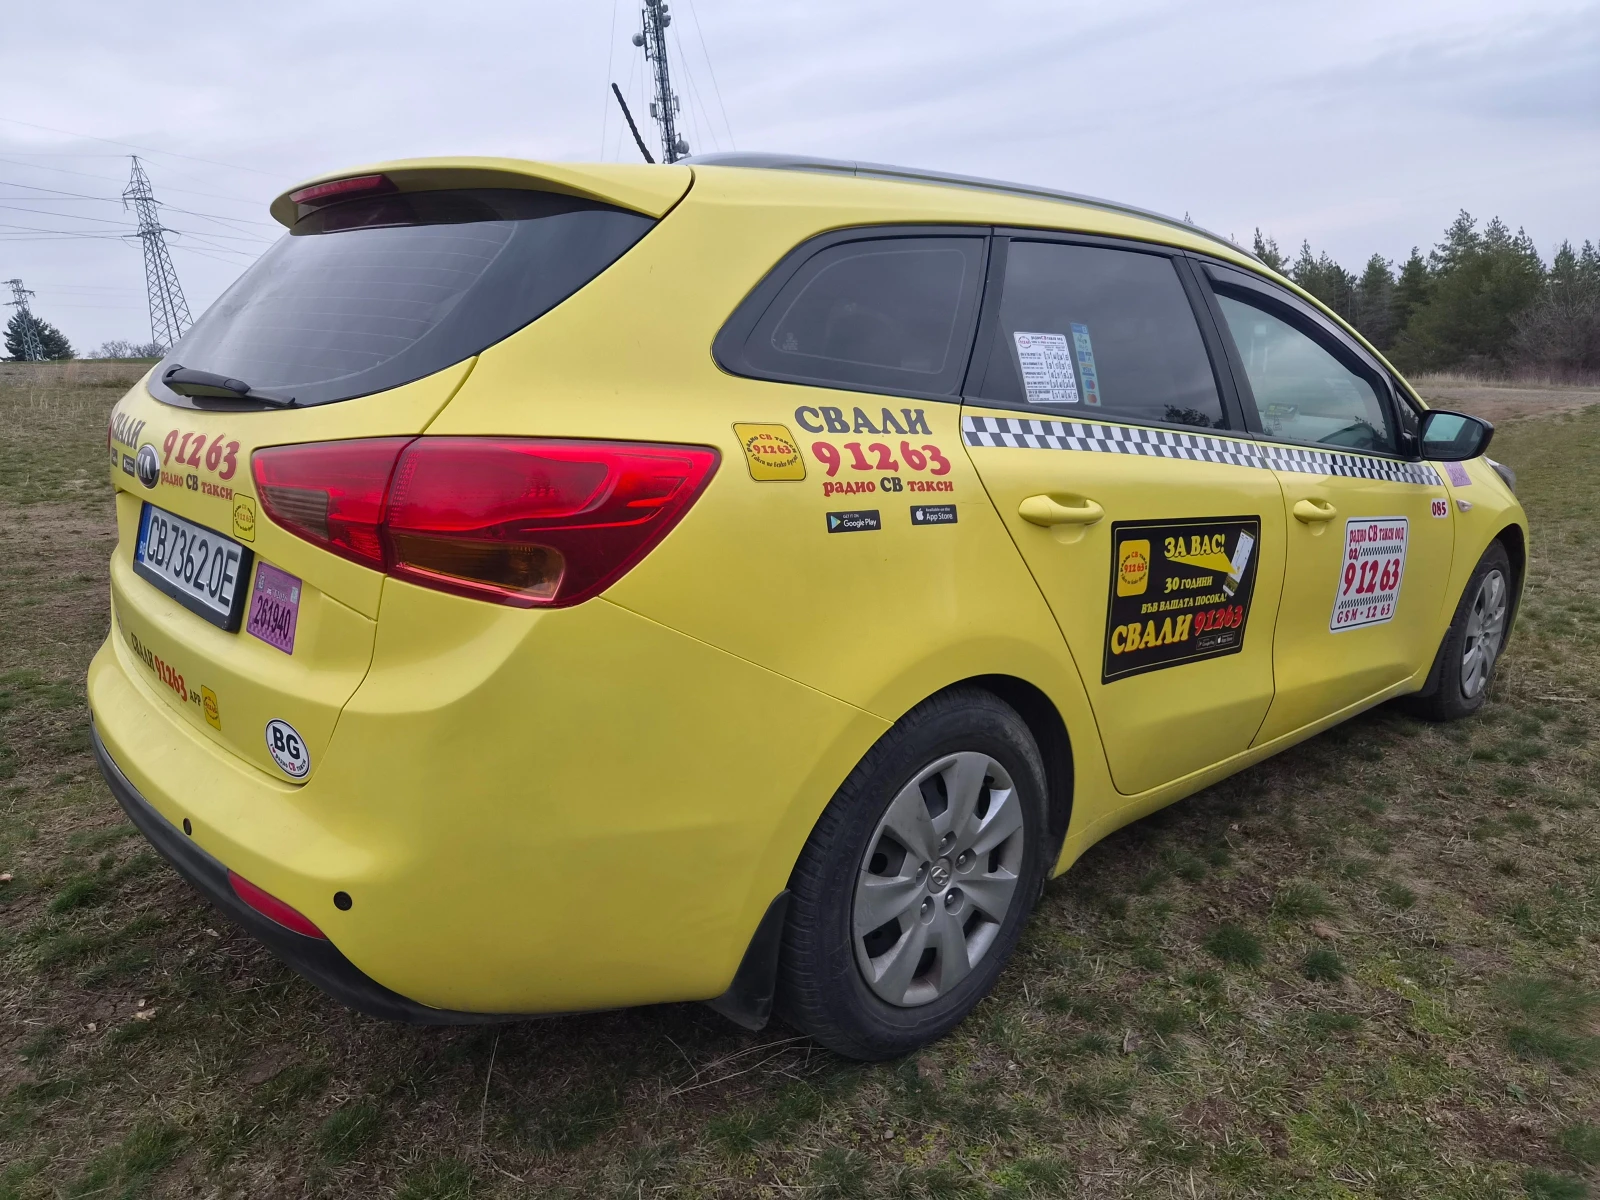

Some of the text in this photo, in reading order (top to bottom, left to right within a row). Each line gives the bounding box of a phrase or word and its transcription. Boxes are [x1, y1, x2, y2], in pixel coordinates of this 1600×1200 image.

[794, 406, 932, 435] СВАЛИ
[163, 429, 240, 480] 91263
[812, 440, 952, 478] 91263
[160, 471, 233, 500] радио СВ такси
[822, 477, 954, 497] радио СВ такси
[926, 512, 953, 521] App Store
[1432, 501, 1446, 516] 085
[844, 518, 876, 528] Google Play
[1164, 534, 1226, 558] ЗА ВАС!
[1350, 525, 1404, 546] радио СВ такси оод
[1164, 577, 1180, 594] 30
[1180, 576, 1212, 590] ГОДИНИ
[1141, 593, 1228, 614] ВЪВ ВАШАТА ПОСОКА!
[254, 595, 291, 640] 261940
[1337, 608, 1357, 624] GSM
[1111, 604, 1243, 655] СВАЛИ 91263
[154, 655, 188, 702] 91263
[272, 726, 300, 760] BG
